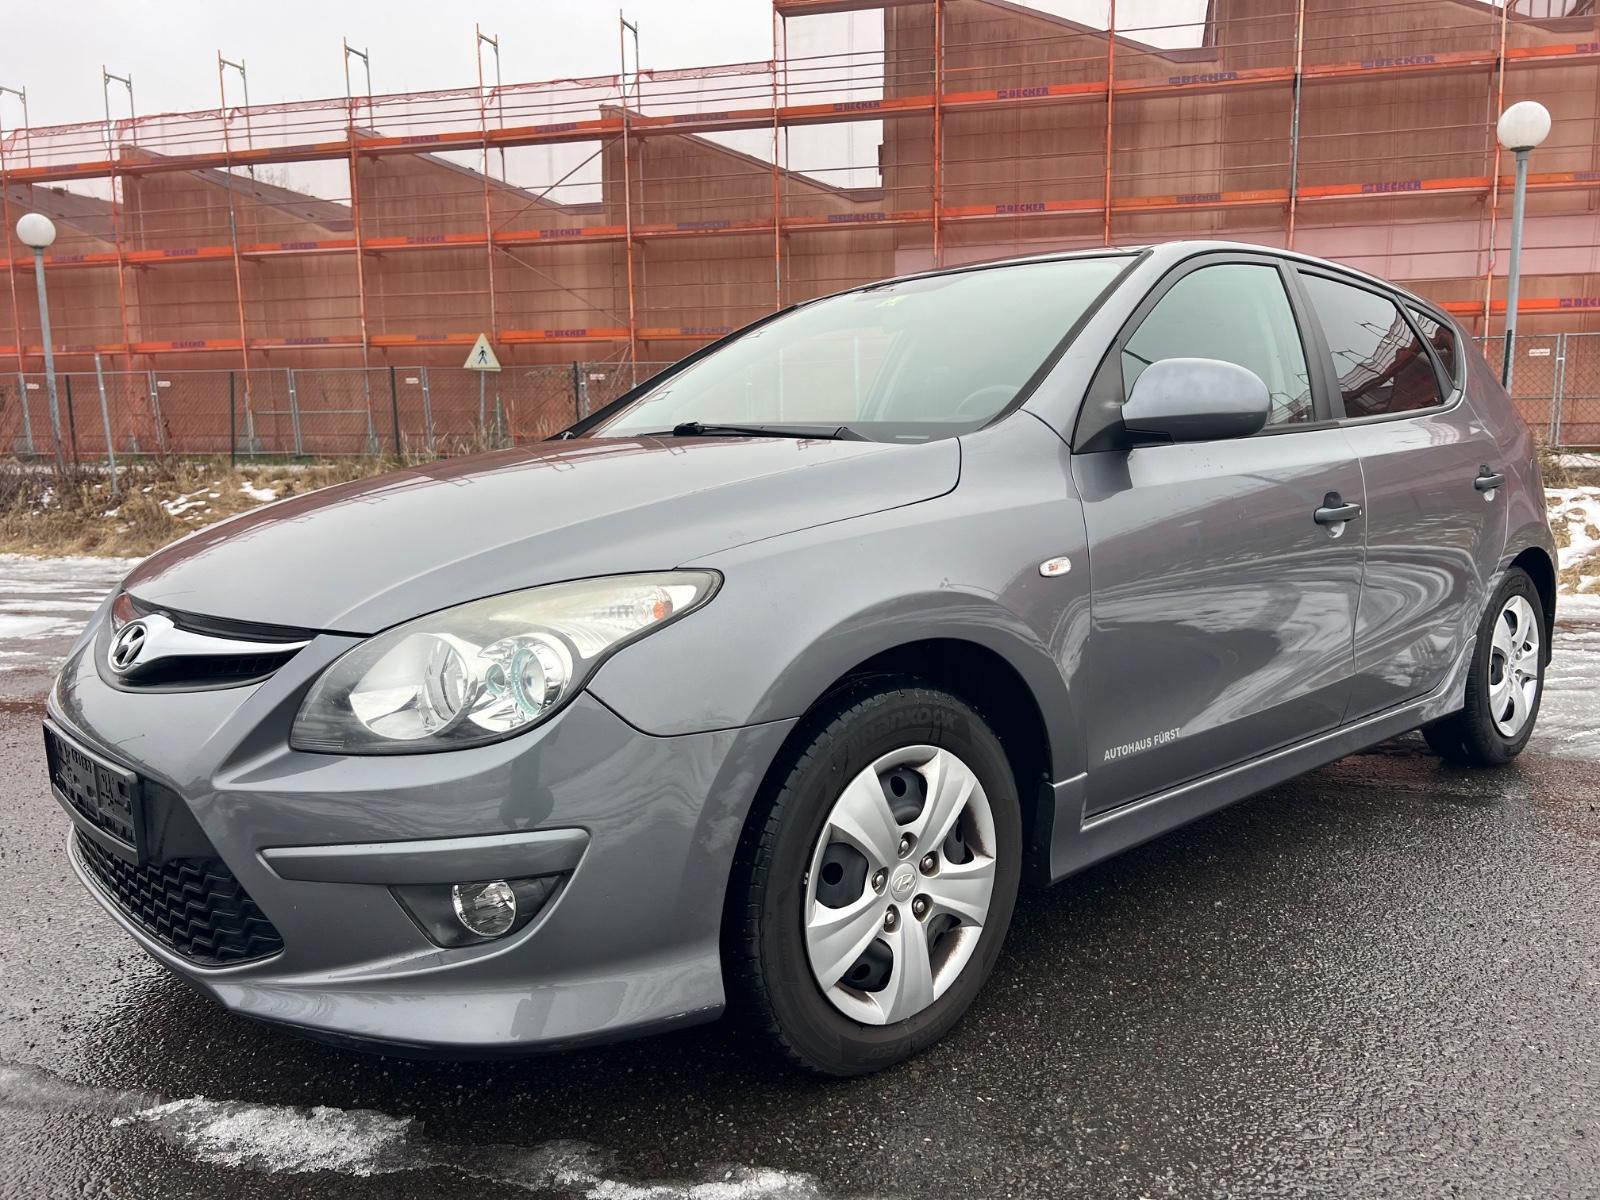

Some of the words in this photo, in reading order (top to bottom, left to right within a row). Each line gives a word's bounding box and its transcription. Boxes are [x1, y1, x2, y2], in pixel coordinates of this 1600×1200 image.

[1375, 55, 1435, 67] BECKER
[1182, 72, 1237, 83] BECKER
[1009, 87, 1048, 98] BECKER
[844, 100, 880, 112] BECKER
[1376, 180, 1421, 192] BECKER
[1007, 203, 1045, 213] BECKER
[1575, 297, 1600, 307] BEC
[554, 329, 586, 337] BECKER
[1104, 737, 1152, 761] AUTOHAUS
[1154, 727, 1180, 745] FÜRST
